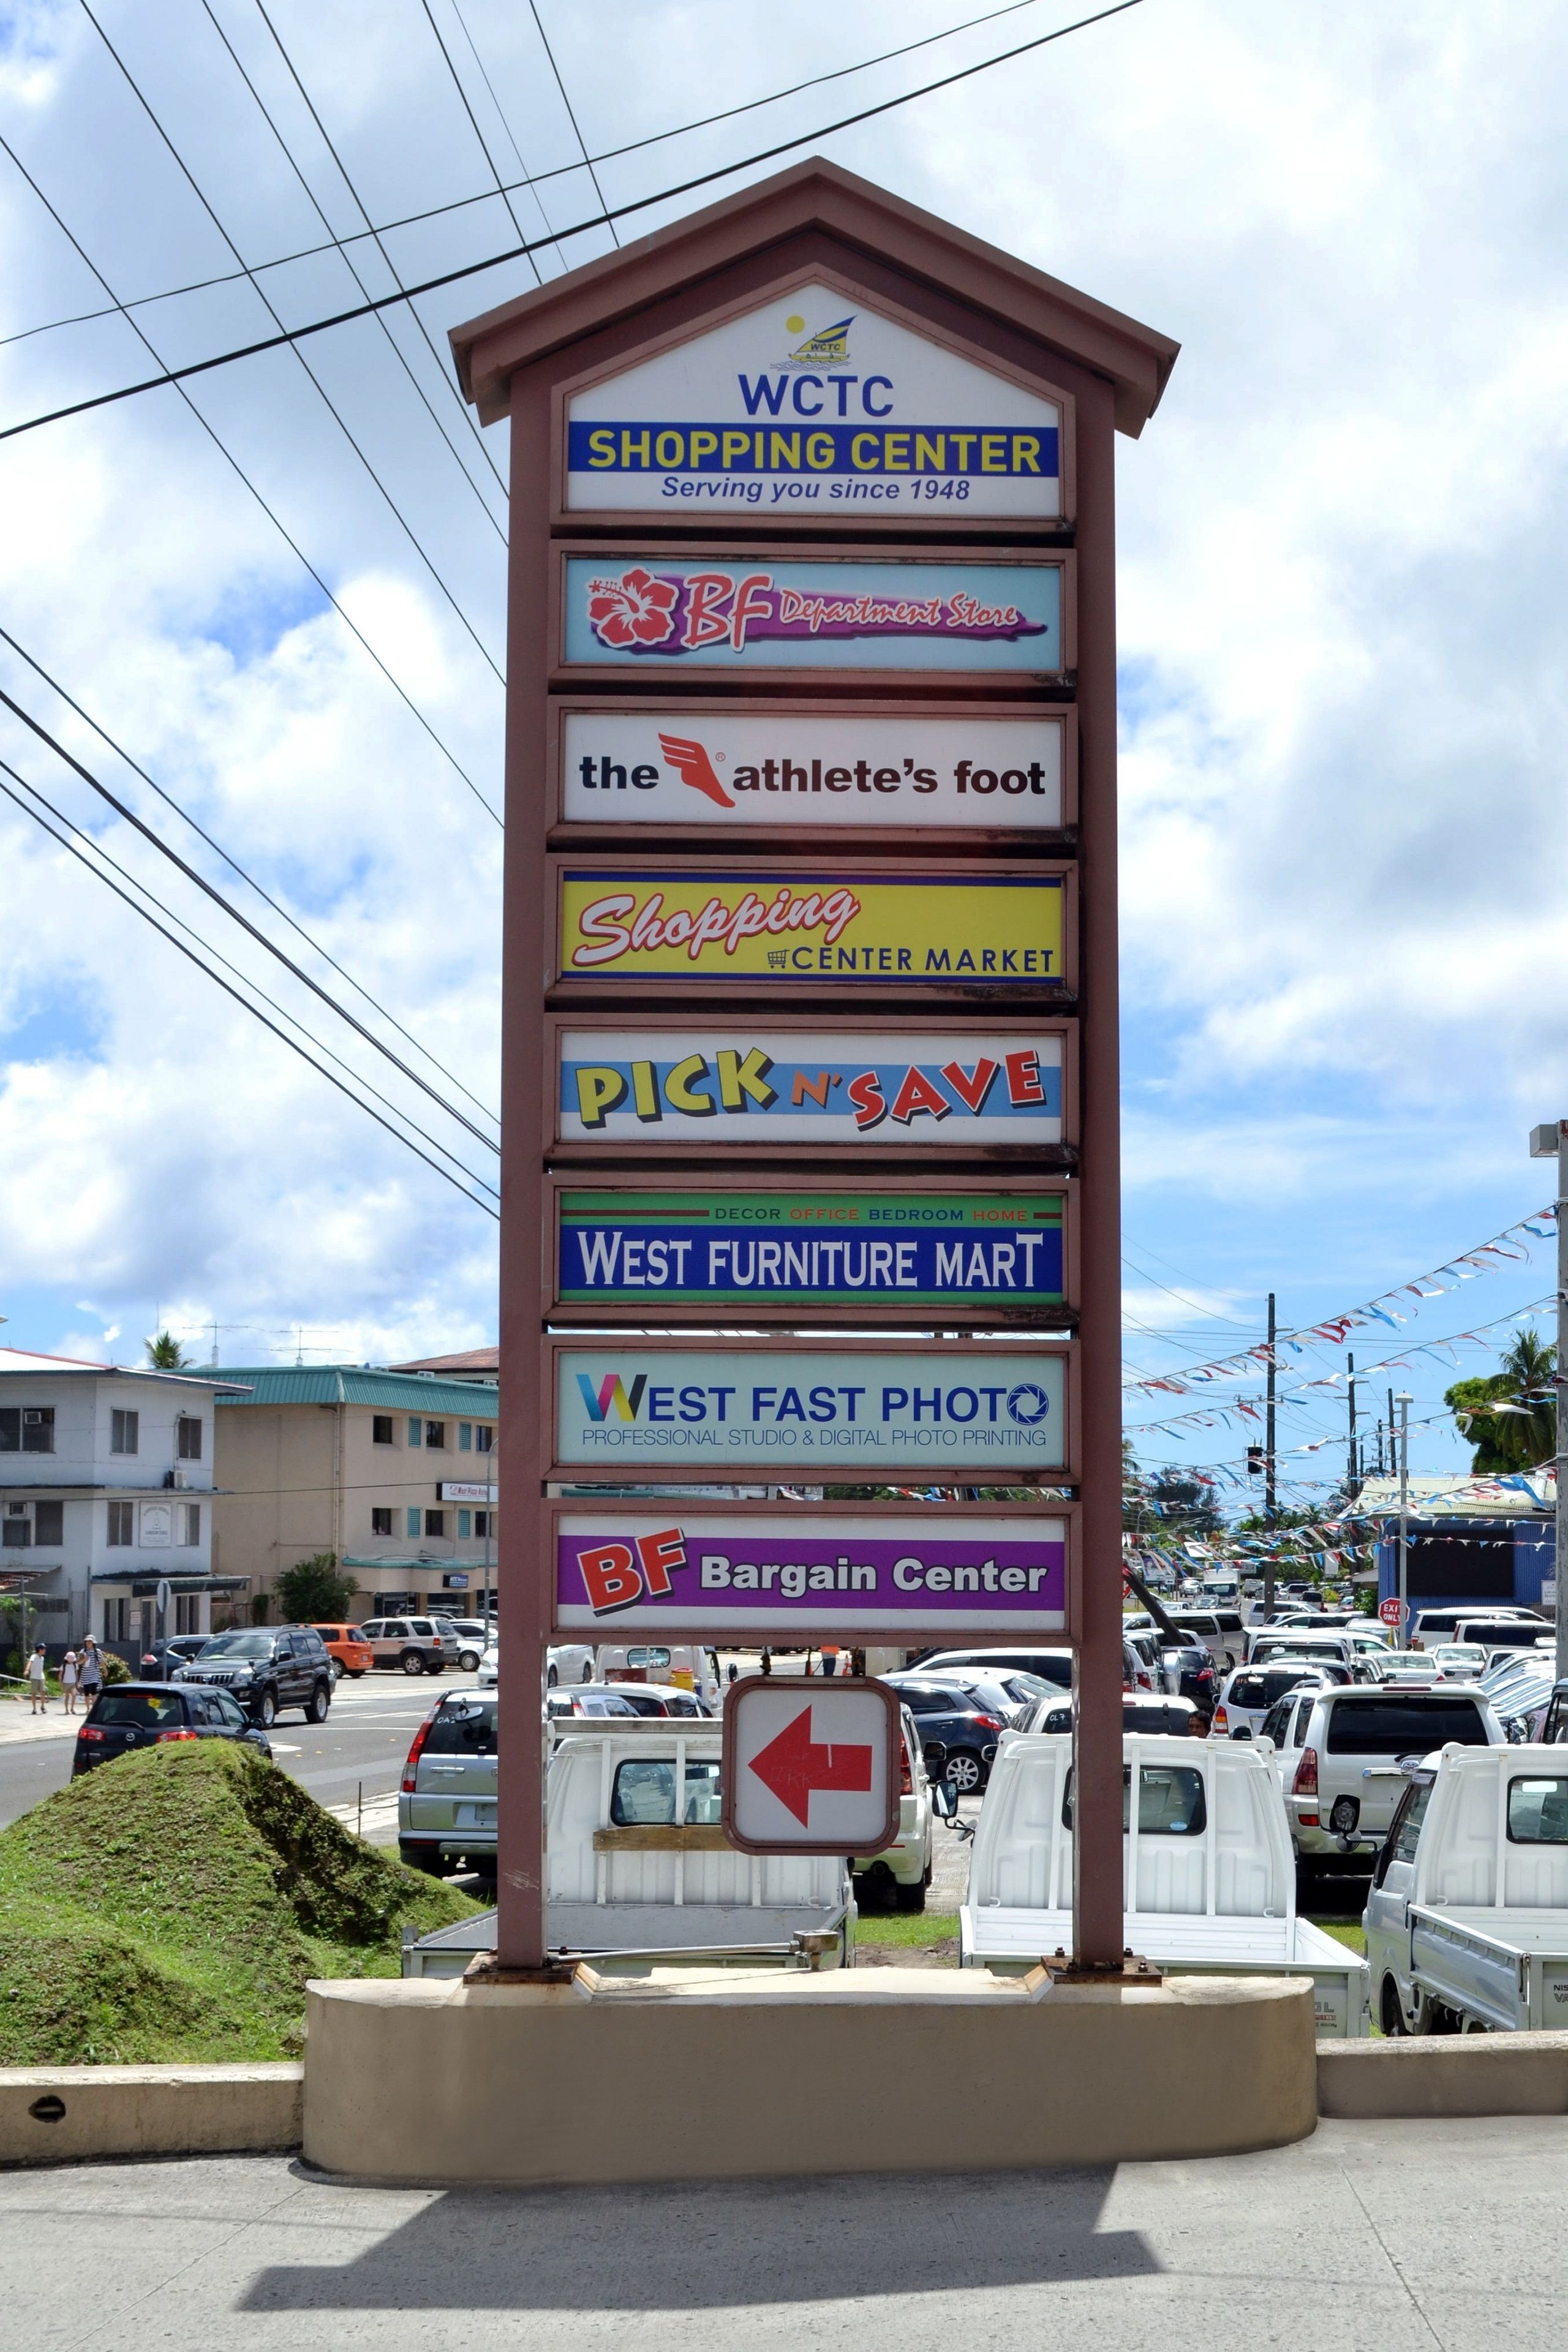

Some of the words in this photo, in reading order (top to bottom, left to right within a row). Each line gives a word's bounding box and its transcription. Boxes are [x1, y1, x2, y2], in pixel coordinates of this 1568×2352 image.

[738, 374, 894, 417] WCTC
[589, 430, 836, 470] SHOPPING
[851, 433, 1042, 473] CENTER
[662, 477, 762, 503] Serving
[771, 483, 820, 503] you
[829, 478, 900, 499] since
[910, 480, 971, 500] 1948
[683, 573, 775, 651] BF
[780, 588, 940, 634] Department
[946, 593, 1019, 628] Store
[579, 756, 660, 790] the
[733, 758, 938, 793] athlete's
[954, 760, 1046, 795] foot
[571, 887, 861, 966] Shopping
[792, 946, 913, 971] CENTER
[925, 949, 1053, 973] MARKET
[575, 1046, 780, 1130] PICK
[847, 1049, 1045, 1132] SAVE
[715, 1208, 782, 1220] DECOR
[790, 1208, 859, 1221] OFFICE
[869, 1209, 964, 1221] BEDROOM
[973, 1210, 1028, 1222] HOME
[577, 1231, 692, 1286] WEST
[708, 1240, 918, 1288] FURNITURE
[935, 1232, 1044, 1289] MART
[576, 1374, 736, 1422] WEST
[752, 1386, 870, 1422] FAST
[582, 1428, 723, 1446] PROFESSIONAL
[728, 1428, 797, 1446] STUDIO
[802, 1429, 815, 1446] &
[820, 1429, 887, 1446] DIGITAL
[892, 1430, 957, 1446] PHOTO
[963, 1430, 1047, 1446] PRINTING
[576, 1527, 688, 1617] BF
[700, 1555, 877, 1598] Bargain
[892, 1556, 1049, 1594] Center
[1384, 1604, 1401, 1613] EXI
